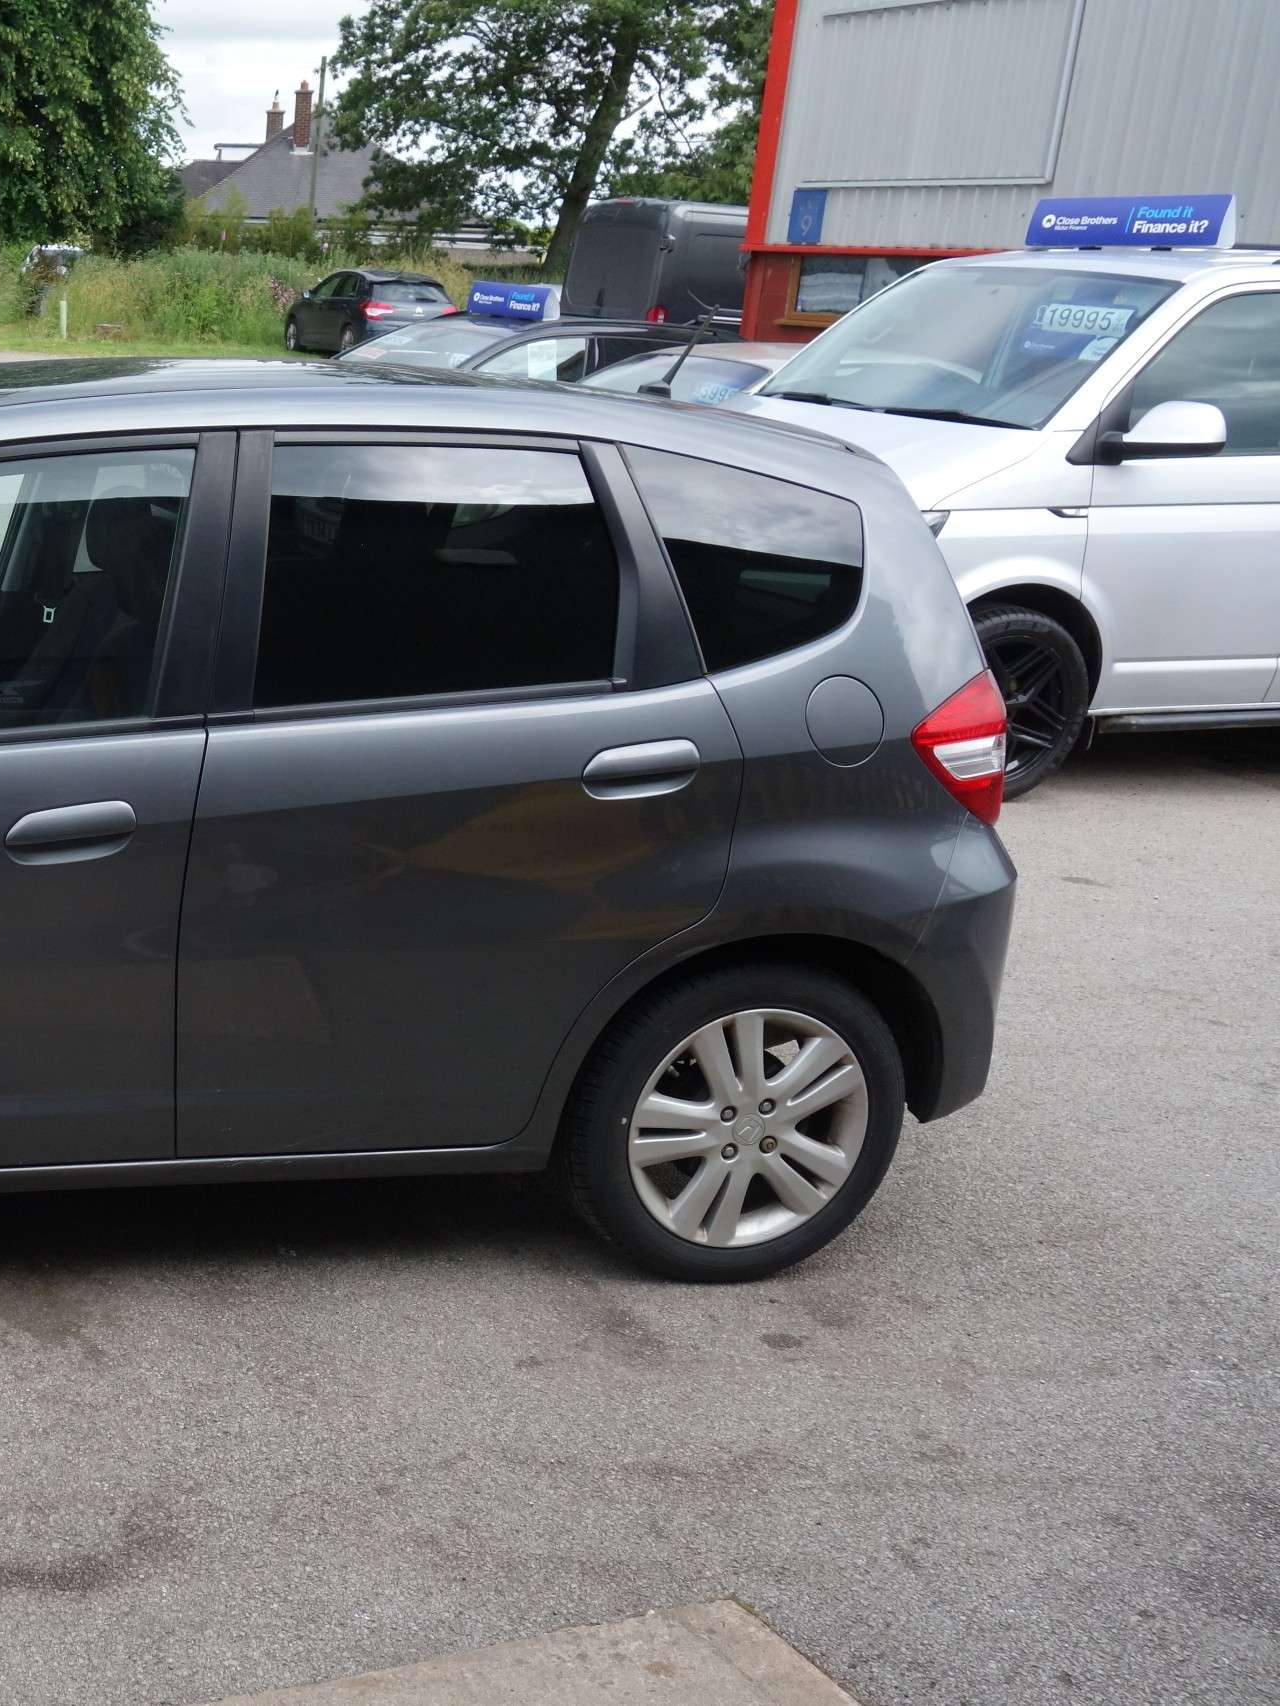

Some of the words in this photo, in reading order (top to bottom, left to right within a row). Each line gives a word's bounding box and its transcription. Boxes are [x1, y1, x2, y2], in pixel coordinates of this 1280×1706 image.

[1137, 206, 1182, 218] Found
[1183, 206, 1194, 218] it
[1056, 217, 1081, 225] Close
[1081, 216, 1118, 225] Brothers
[1132, 220, 1187, 233] Finance
[1188, 220, 1209, 233] it?
[512, 291, 531, 300] Found
[509, 300, 532, 311] Finance
